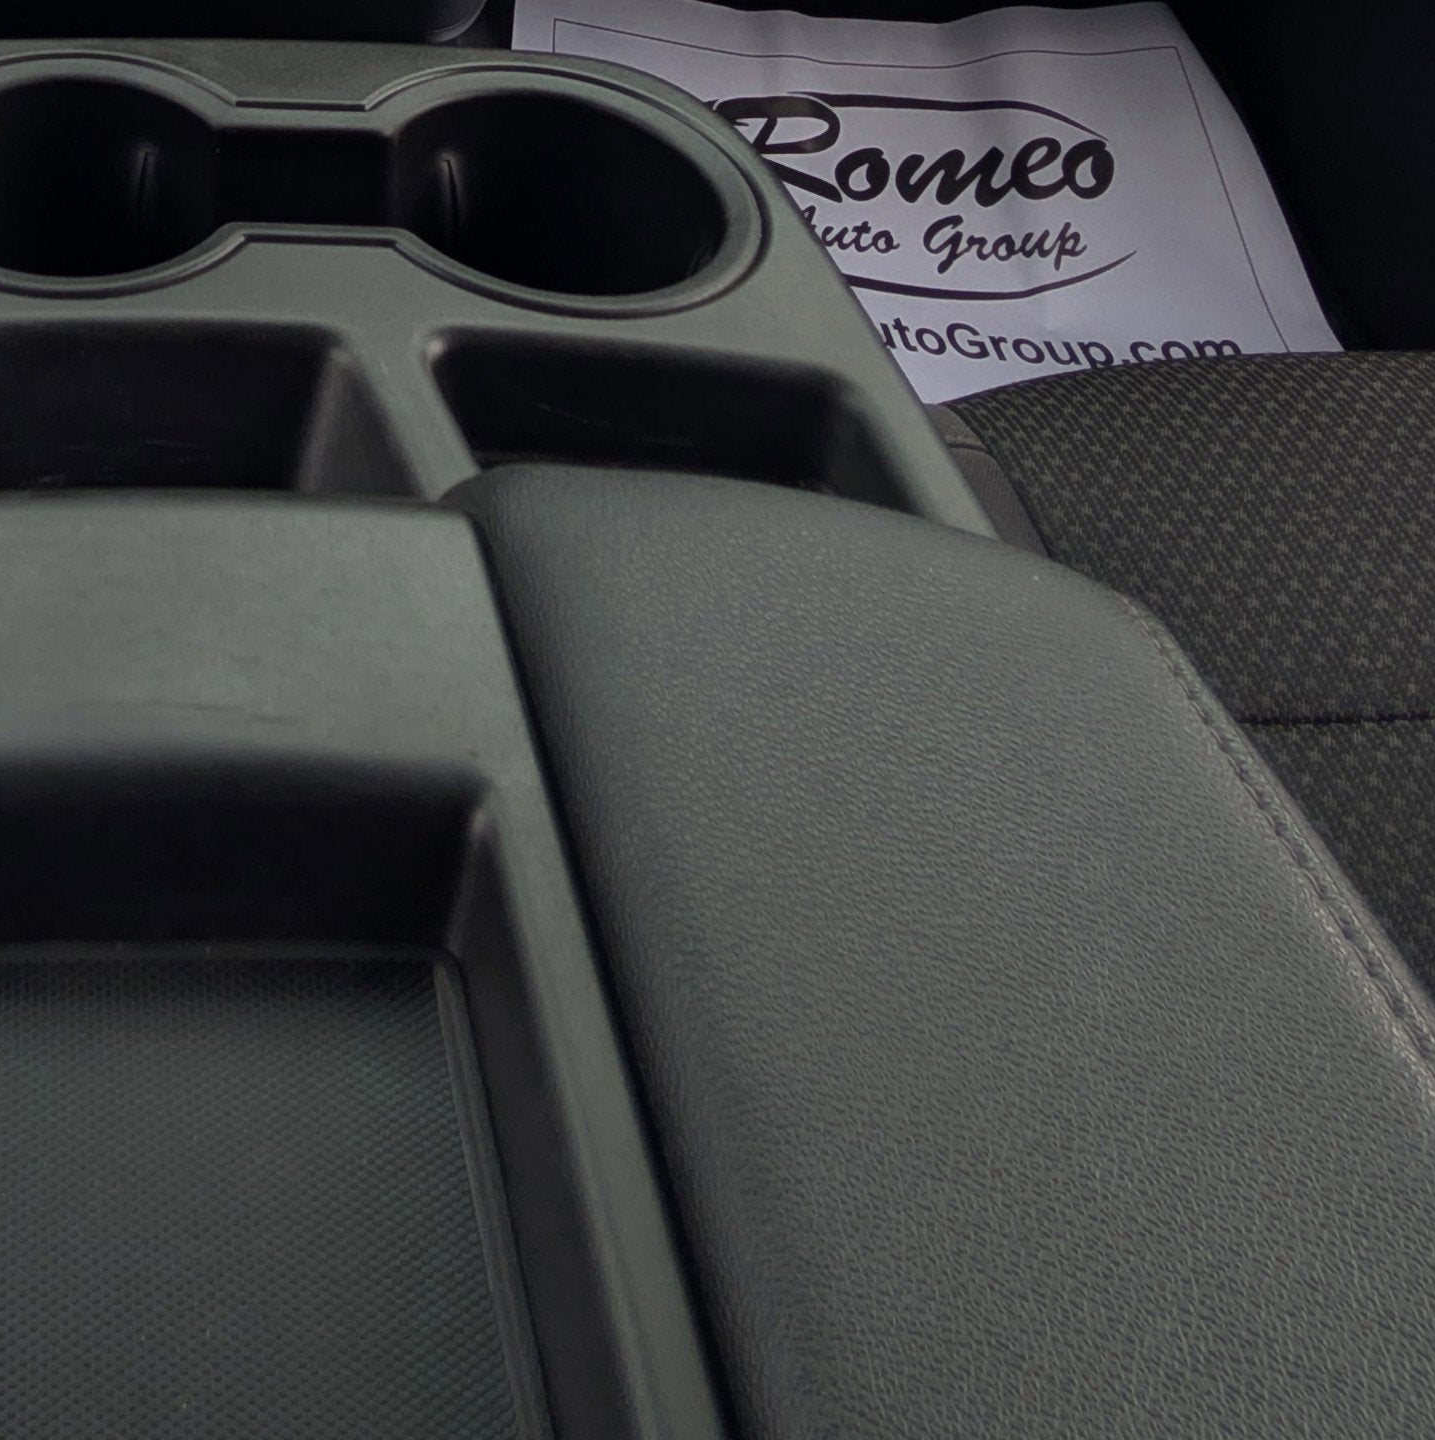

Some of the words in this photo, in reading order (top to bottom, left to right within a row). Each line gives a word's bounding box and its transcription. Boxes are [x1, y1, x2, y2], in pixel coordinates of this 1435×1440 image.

[715, 96, 1115, 208] Romeo
[923, 215, 1088, 275] Group
[879, 317, 1241, 369] utoGroup.com
